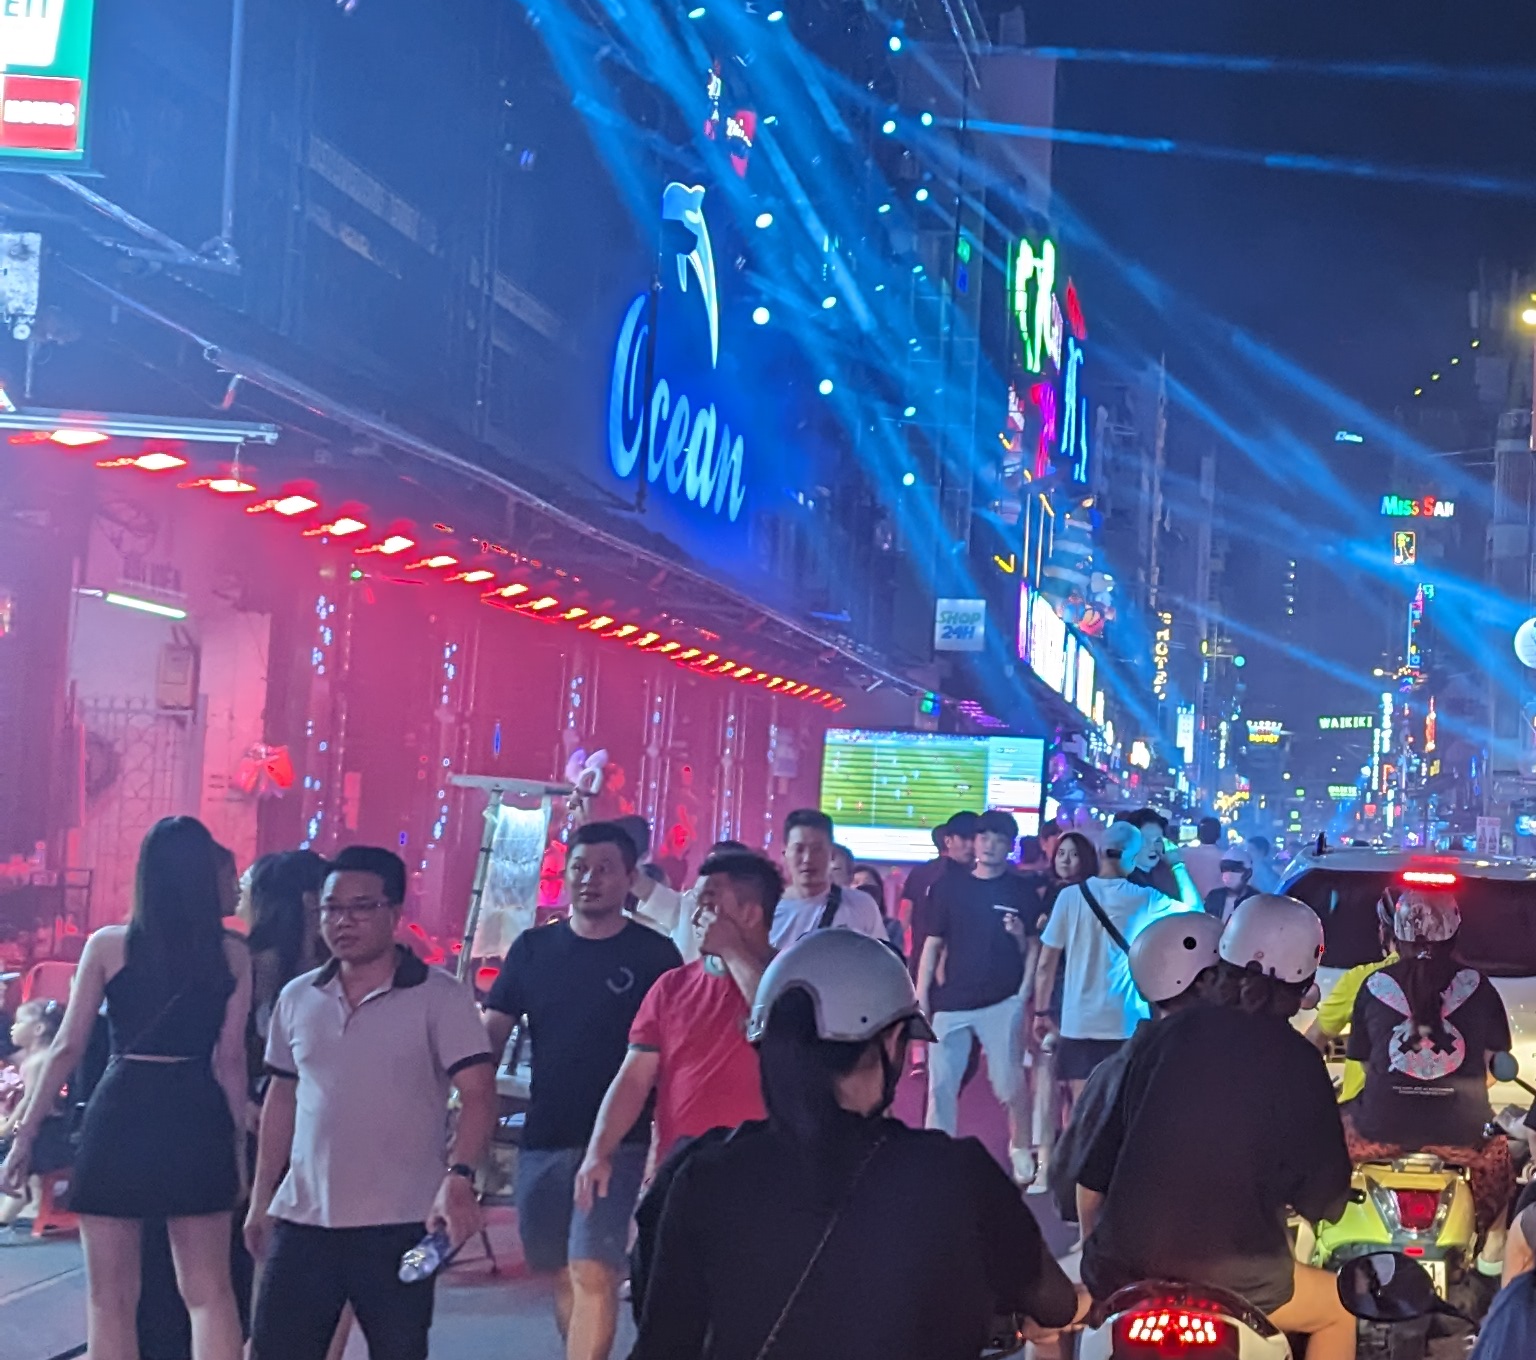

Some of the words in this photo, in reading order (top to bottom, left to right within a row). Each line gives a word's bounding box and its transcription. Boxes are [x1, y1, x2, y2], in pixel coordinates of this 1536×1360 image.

[609, 294, 746, 523] Ocean
[936, 610, 981, 625] SHOP
[941, 625, 977, 640] 24H
[1319, 716, 1373, 730] WAIKIKI
